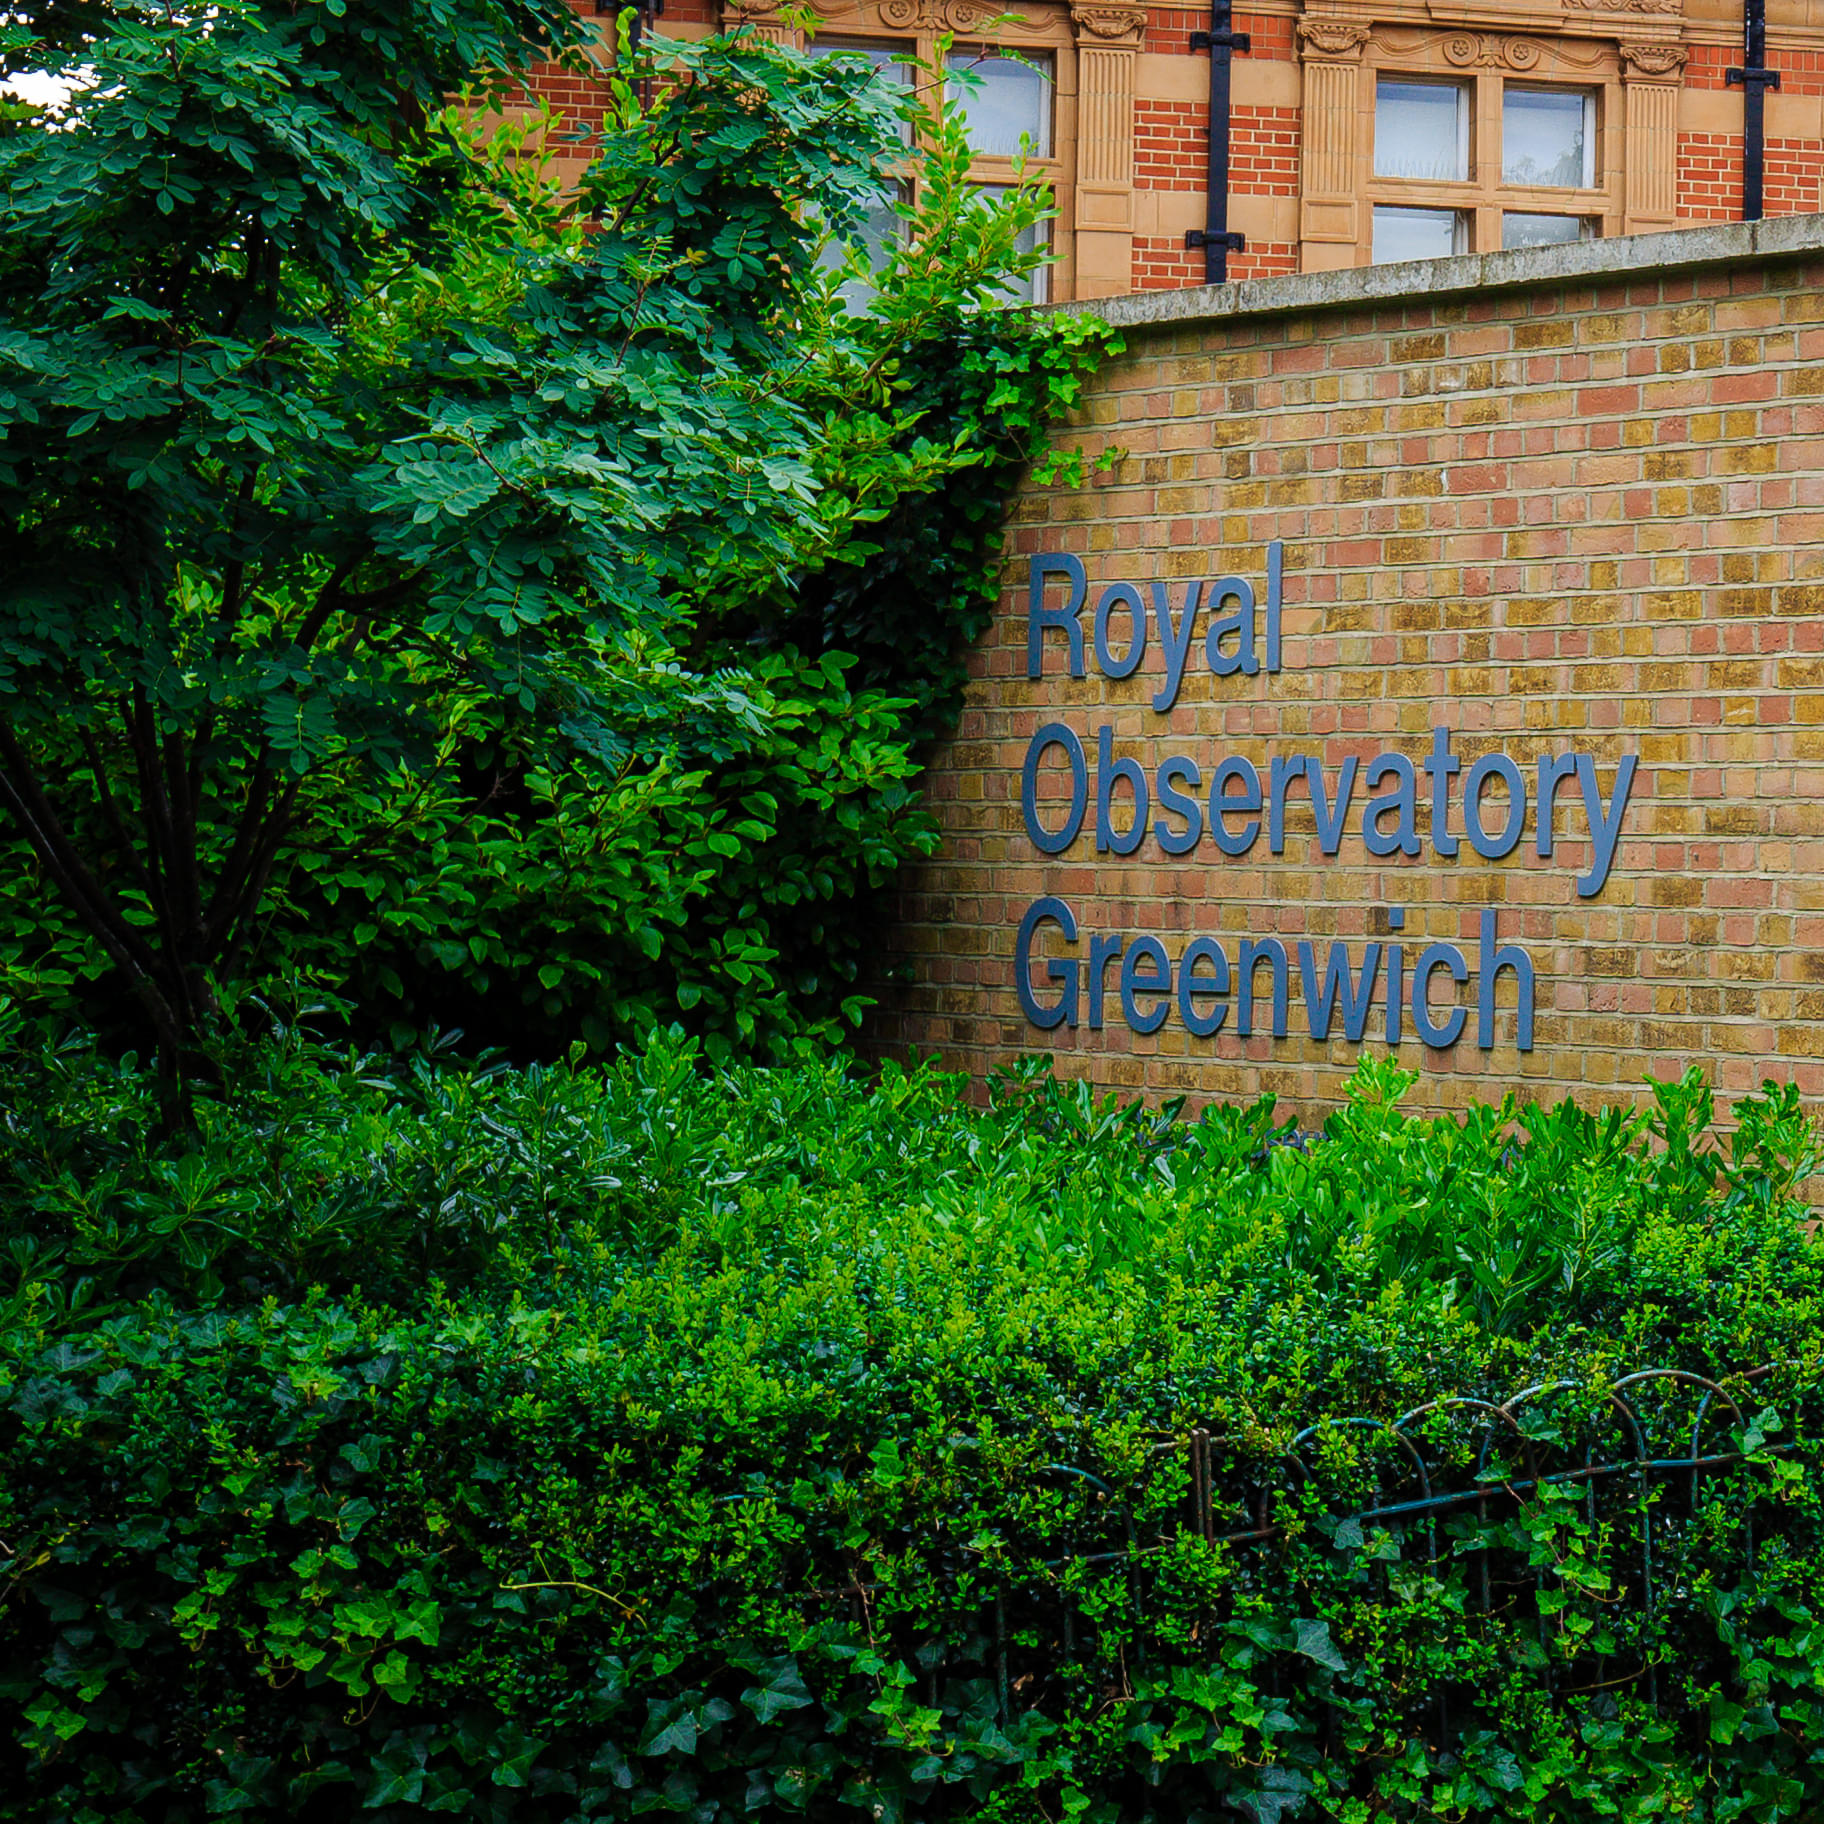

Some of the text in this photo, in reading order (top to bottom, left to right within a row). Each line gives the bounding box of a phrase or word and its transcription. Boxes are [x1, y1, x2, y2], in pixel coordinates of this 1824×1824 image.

[1027, 541, 1284, 713] Royal
[1022, 722, 1639, 897] Observatory
[1015, 896, 1535, 1051] Greenwich
